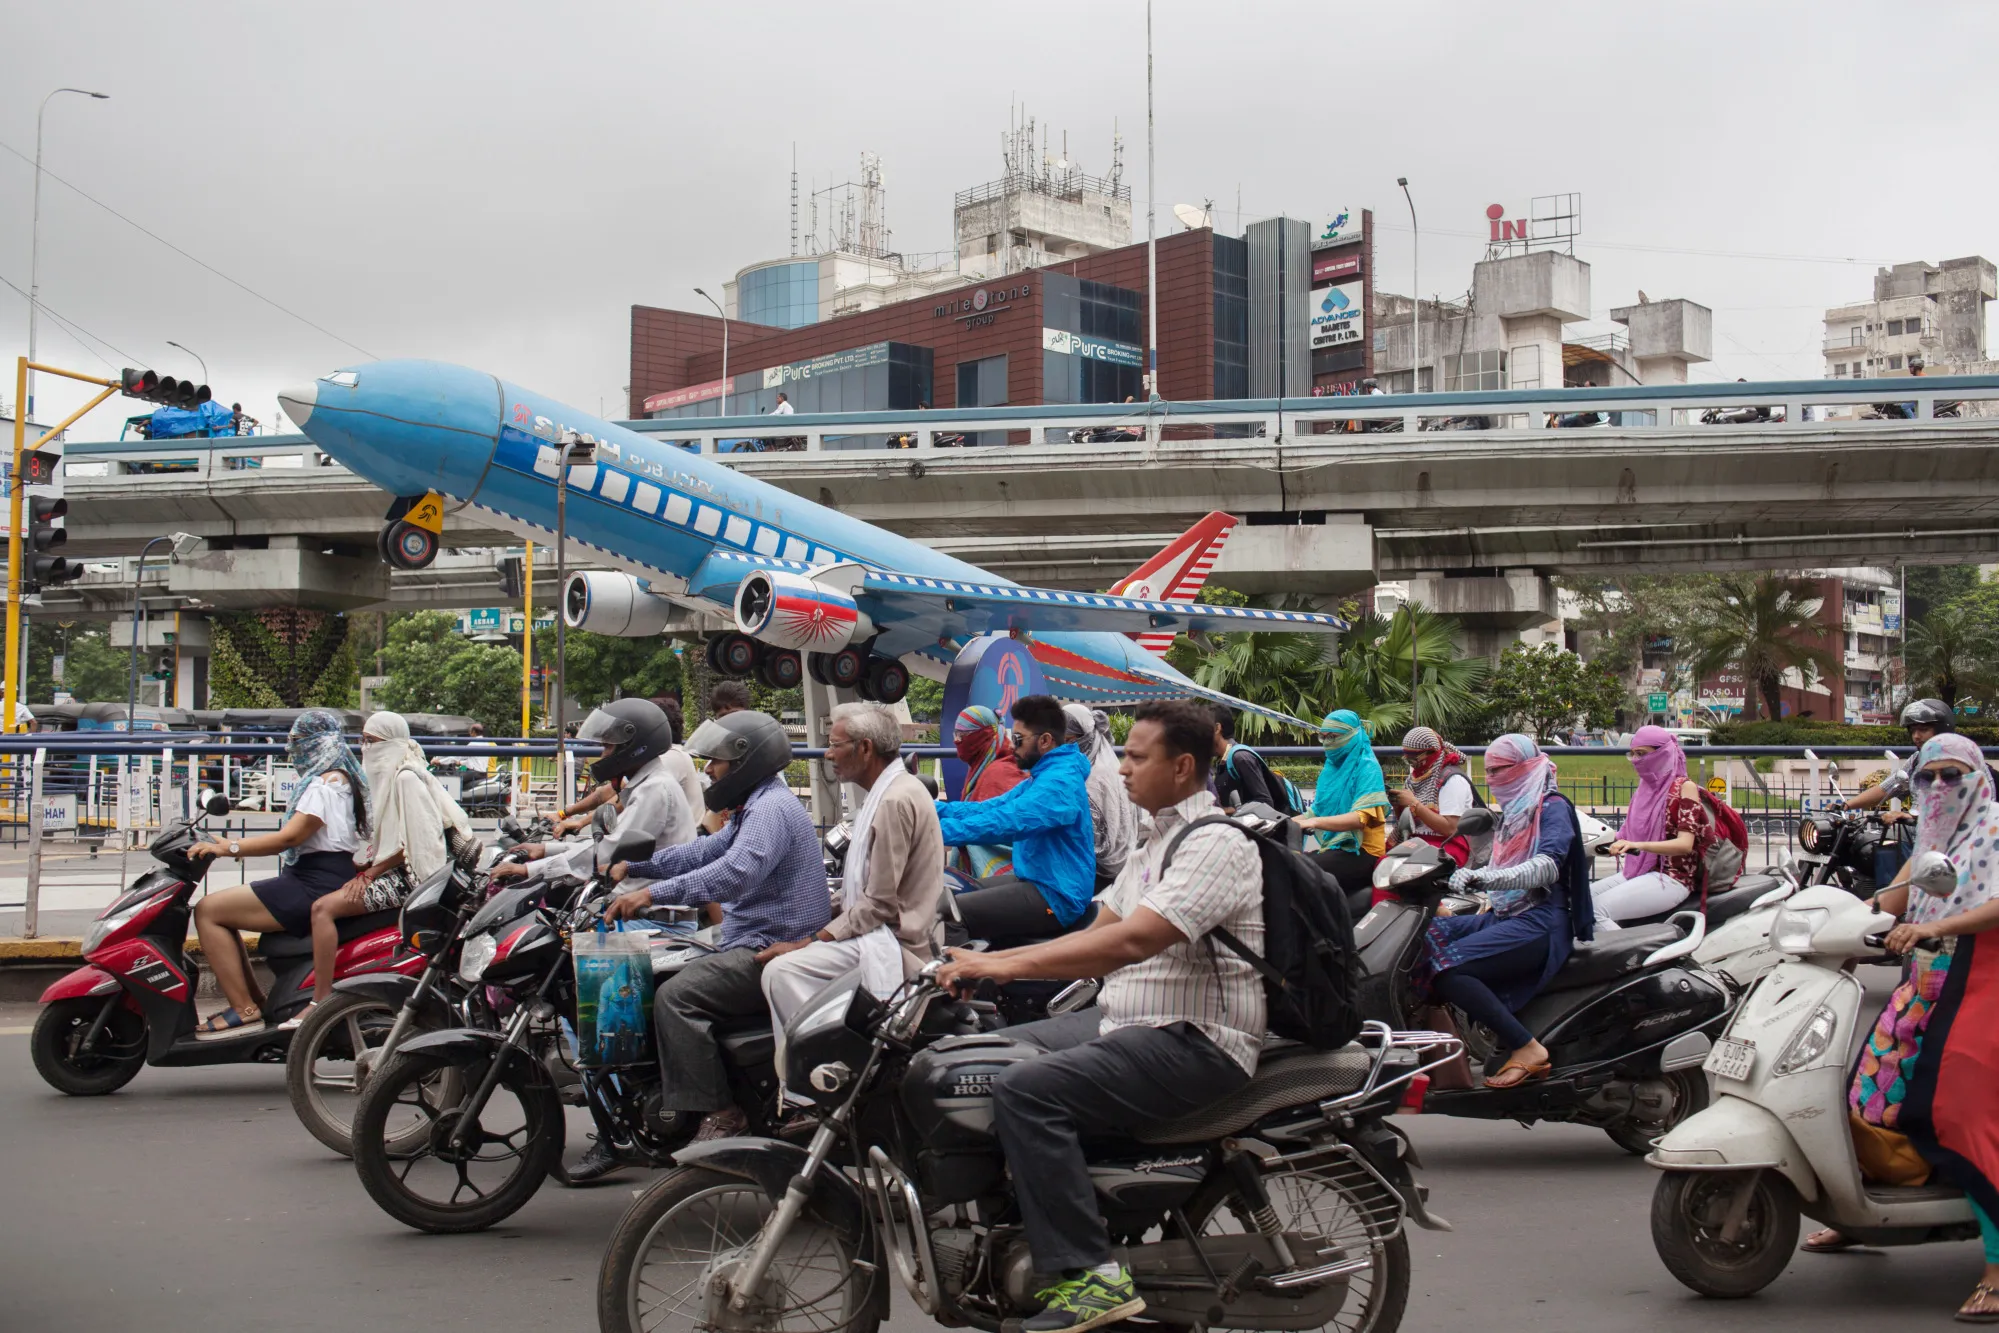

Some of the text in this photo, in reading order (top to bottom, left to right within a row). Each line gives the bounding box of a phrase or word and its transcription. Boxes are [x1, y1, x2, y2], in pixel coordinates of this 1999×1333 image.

[934, 284, 1029, 317] milestone
[965, 314, 994, 330] group
[1311, 309, 1361, 325] ADVANCED
[1321, 321, 1350, 333] DIABETES
[1313, 330, 1359, 345] CENTRE P. LTD.
[1107, 348, 1130, 359] BROKING
[811, 358, 834, 371] BROKING
[833, 356, 844, 366] PVT.
[844, 354, 855, 364] LTD.
[533, 415, 621, 463] SHH
[31, 457, 40, 477] 8
[43, 808, 66, 819] HAH
[146, 970, 170, 983] YAMAHA
[1633, 1009, 1692, 1030] Activa
[1723, 1044, 1748, 1062] GJ05
[1711, 1056, 1749, 1082] MJ5443
[954, 1084, 993, 1095] HON
